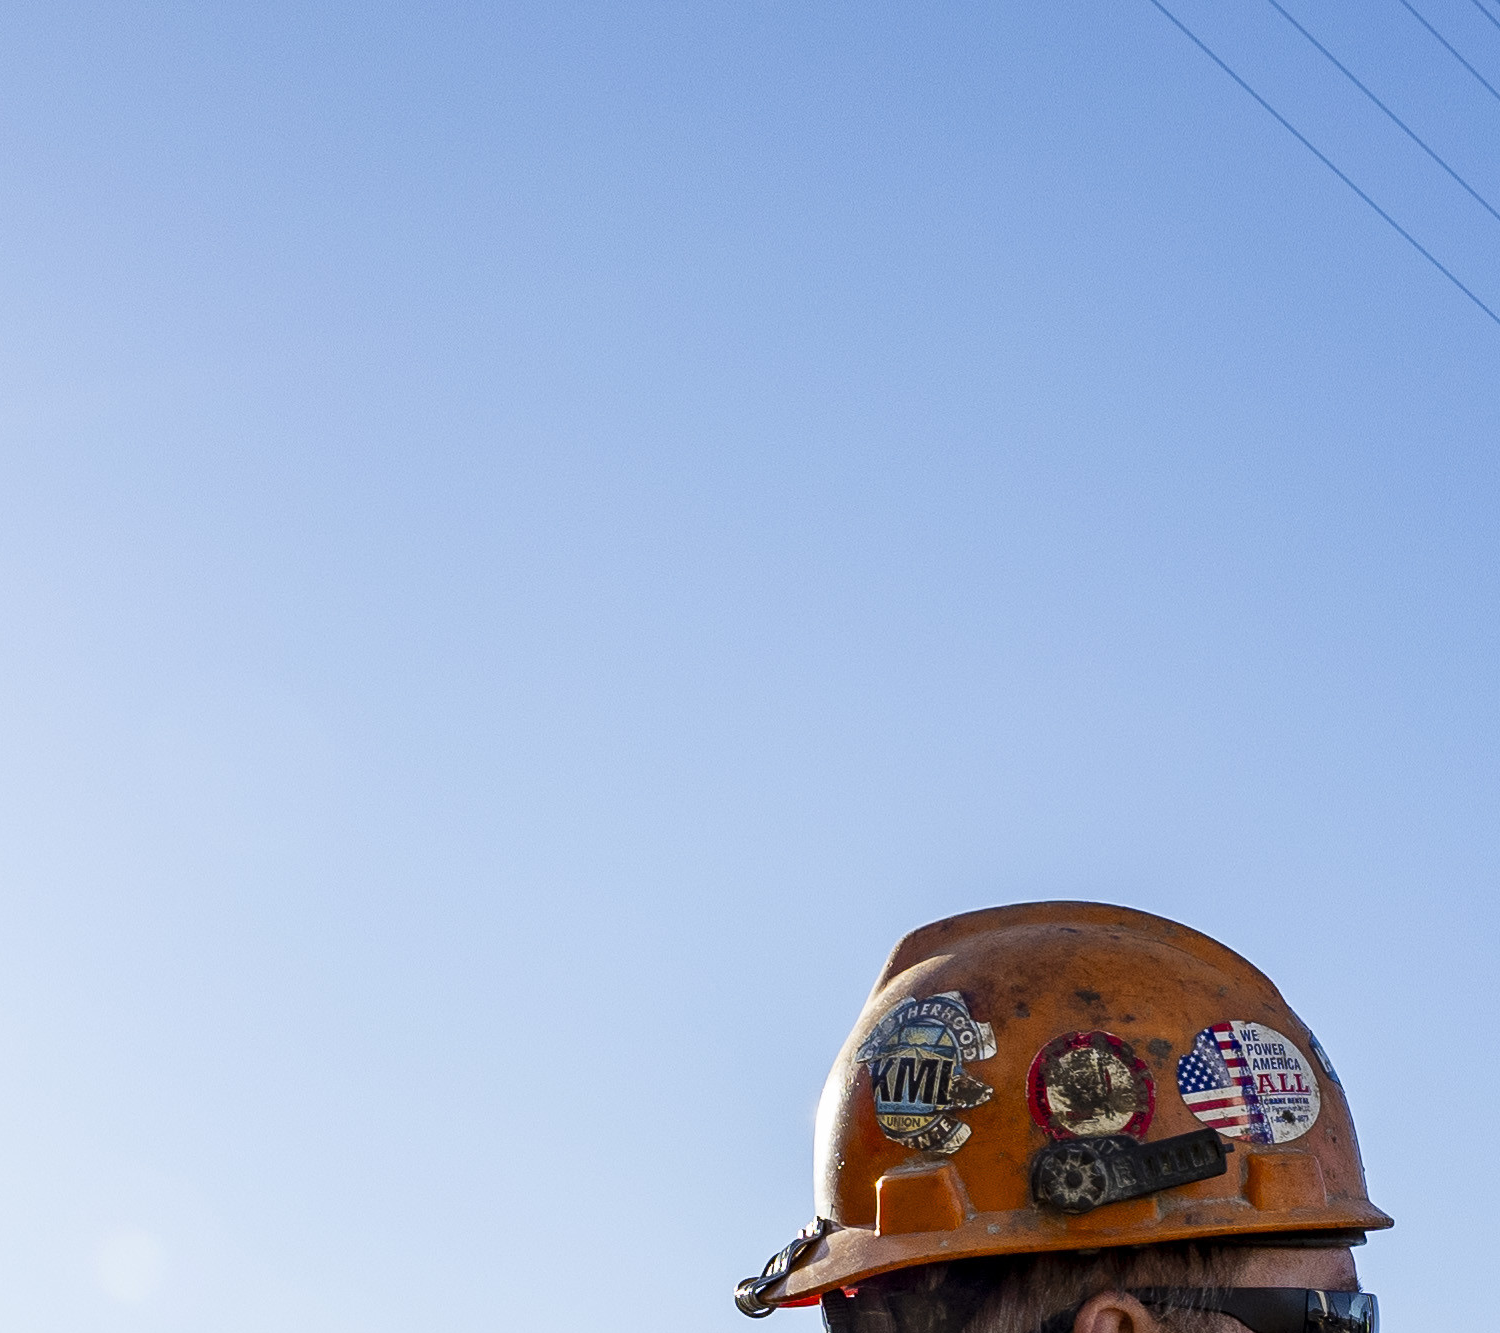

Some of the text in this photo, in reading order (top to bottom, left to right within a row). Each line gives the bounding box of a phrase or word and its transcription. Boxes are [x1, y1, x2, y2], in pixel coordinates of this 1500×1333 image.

[1239, 1029, 1260, 1042] WE
[1246, 1043, 1286, 1057] POWER
[1252, 1057, 1302, 1072] AMERICA
[1257, 1073, 1310, 1095] ALL
[887, 1117, 921, 1128] UNION
